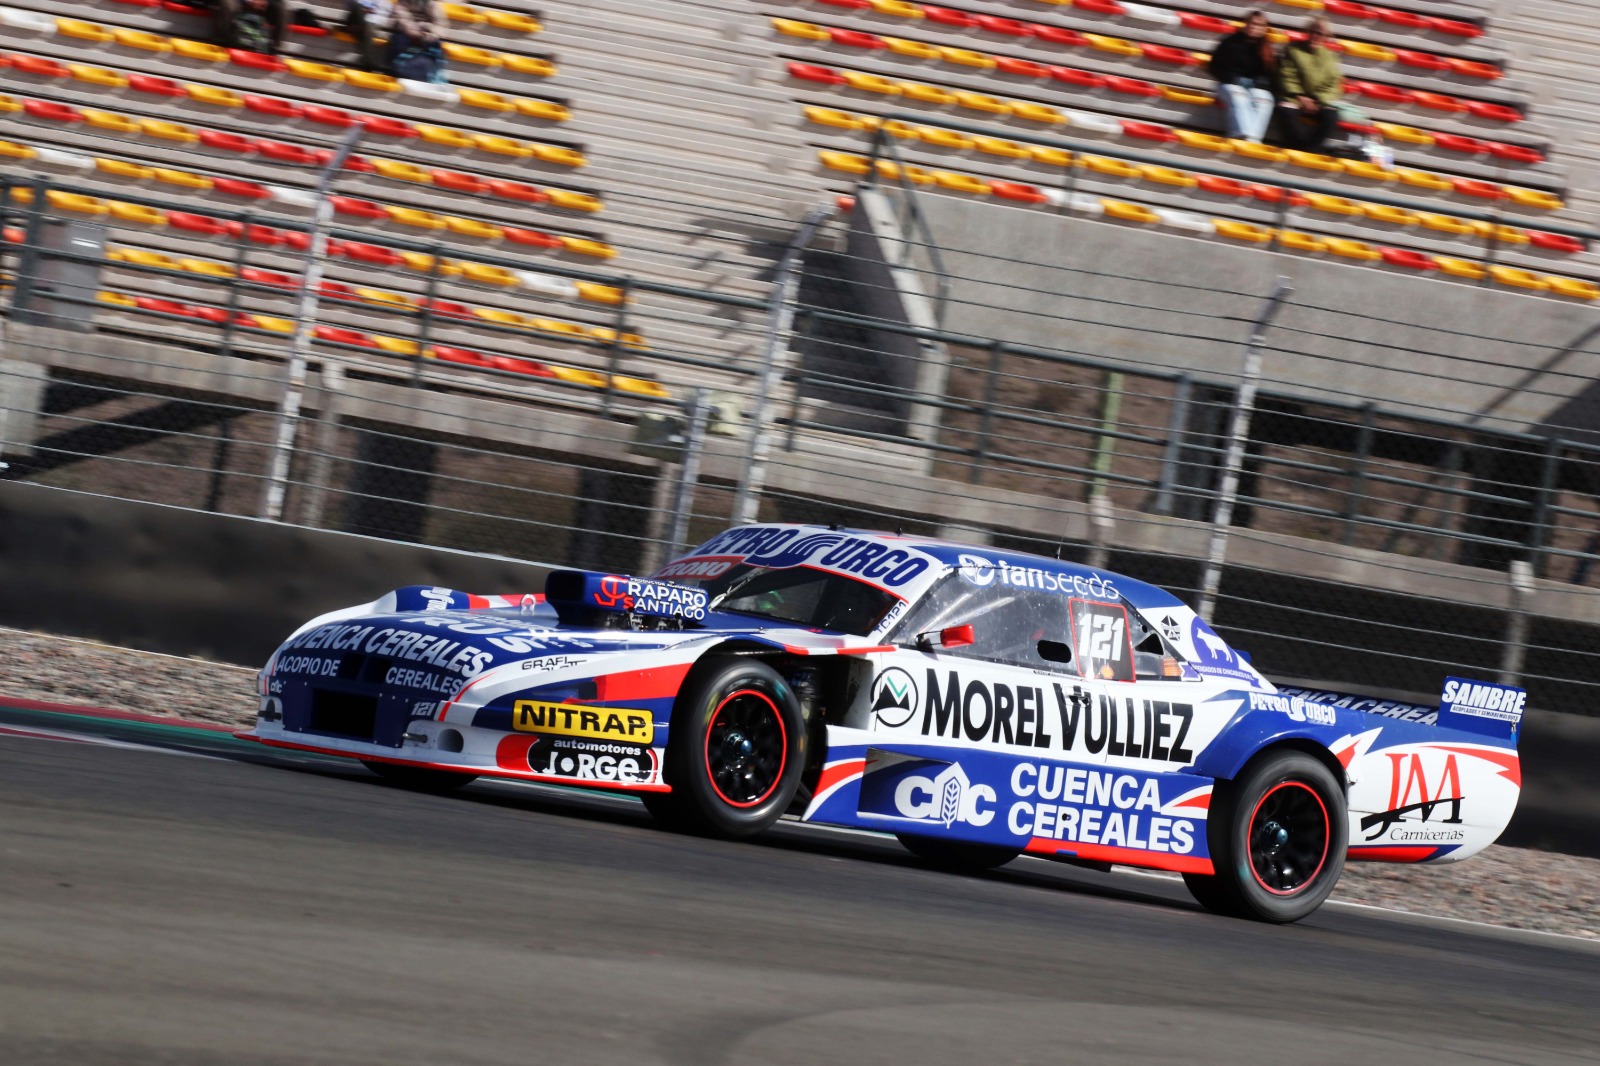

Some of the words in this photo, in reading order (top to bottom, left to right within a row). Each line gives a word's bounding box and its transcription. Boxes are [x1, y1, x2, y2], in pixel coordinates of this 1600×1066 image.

[1000, 560, 1119, 599] fanseeds
[366, 627, 493, 678] CEREALES
[1079, 613, 1125, 661] 121
[276, 656, 320, 675] ACOPIO
[321, 659, 341, 677] DE
[385, 666, 462, 696] CEREALES
[1442, 680, 1526, 714] SAMBRE
[411, 702, 435, 716] 121
[921, 668, 1051, 749] MOREL
[1052, 682, 1194, 763] VULLIEZ
[553, 738, 641, 756] automotores
[1010, 762, 1161, 813] CUENCA
[1008, 802, 1195, 854] CEREALES
